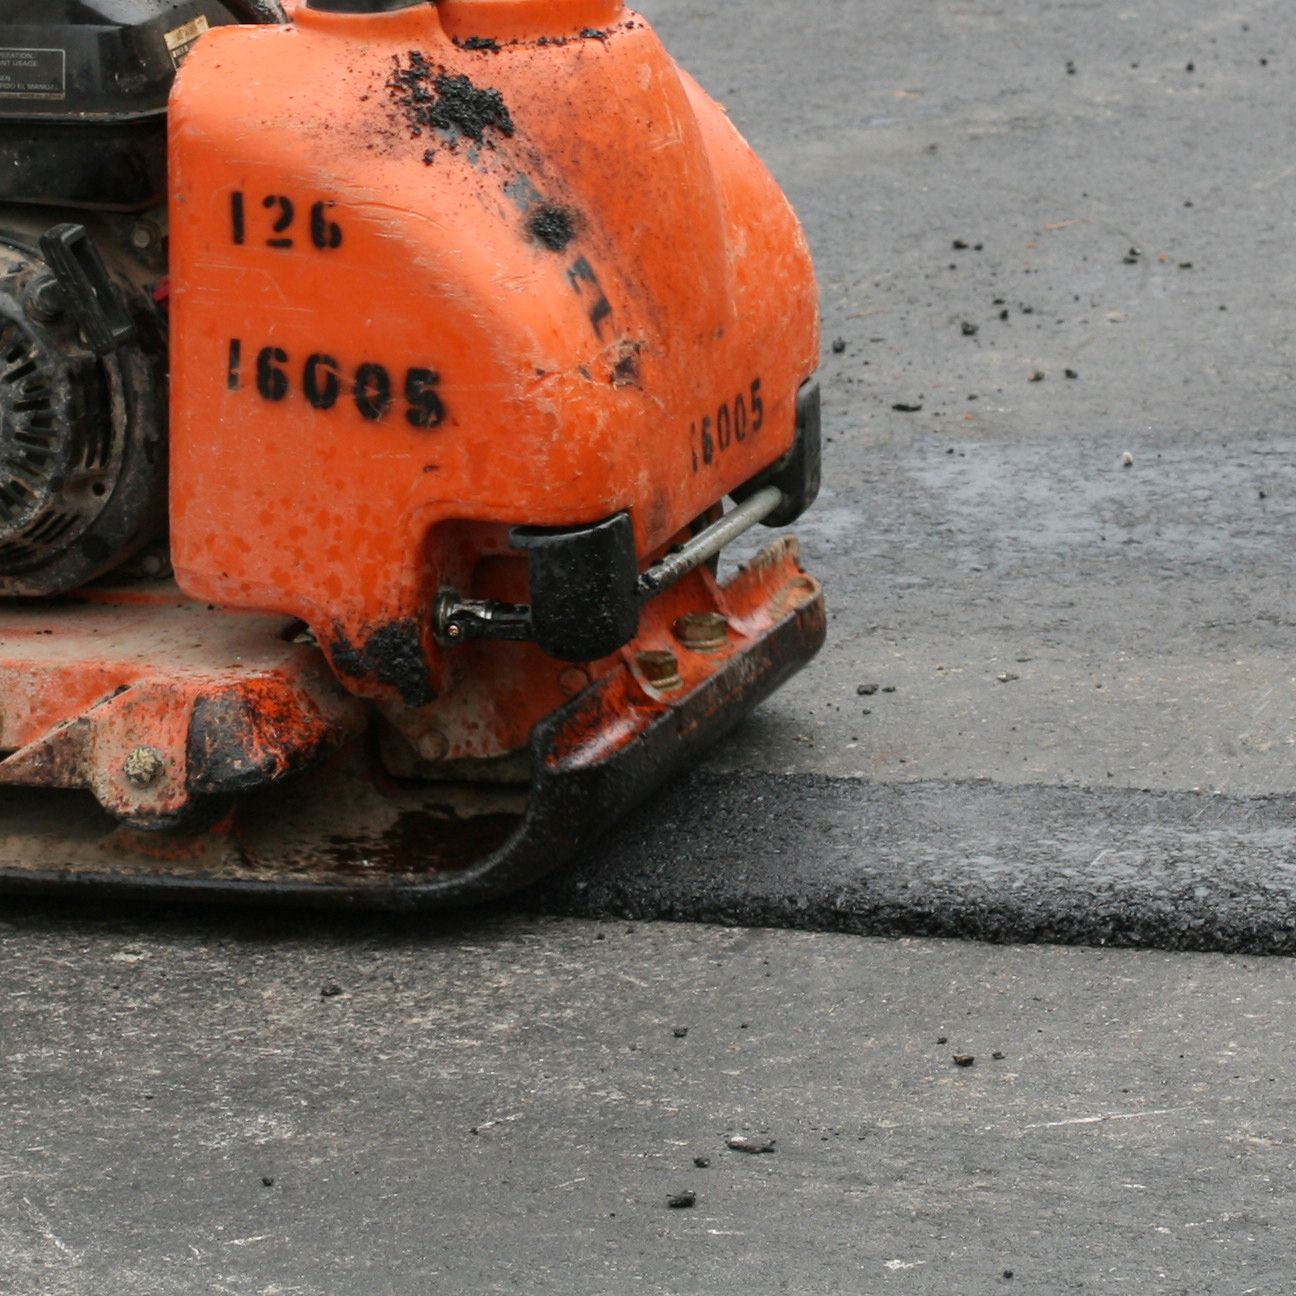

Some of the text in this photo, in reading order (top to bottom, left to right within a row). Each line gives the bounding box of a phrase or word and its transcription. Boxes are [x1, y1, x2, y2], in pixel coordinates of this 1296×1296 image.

[231, 191, 342, 248] 126
[227, 338, 446, 428] 16005
[690, 377, 763, 473] 16005
